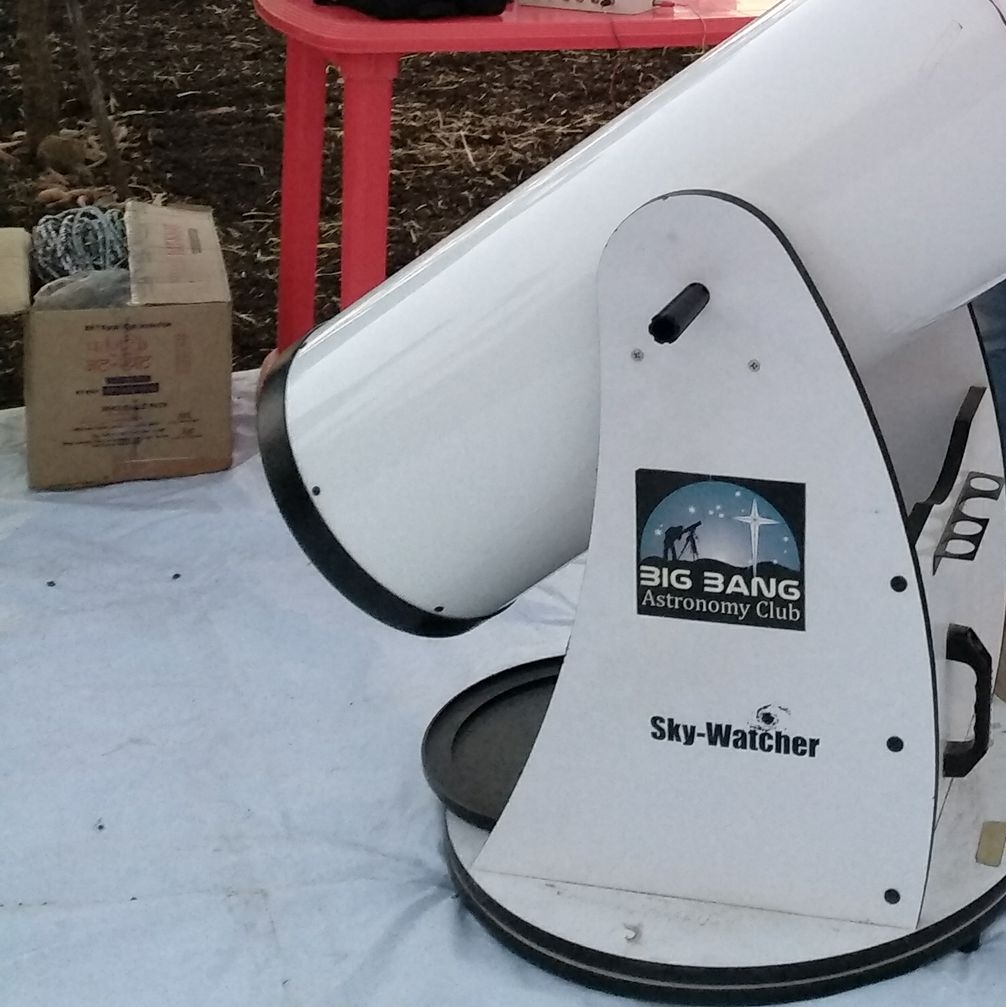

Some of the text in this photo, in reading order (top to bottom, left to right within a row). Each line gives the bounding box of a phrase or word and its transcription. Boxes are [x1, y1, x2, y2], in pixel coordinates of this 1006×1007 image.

[639, 565, 800, 601] BIG BANG
[641, 589, 801, 622] Astronomy Club
[650, 715, 820, 758] Sky-Watcher
